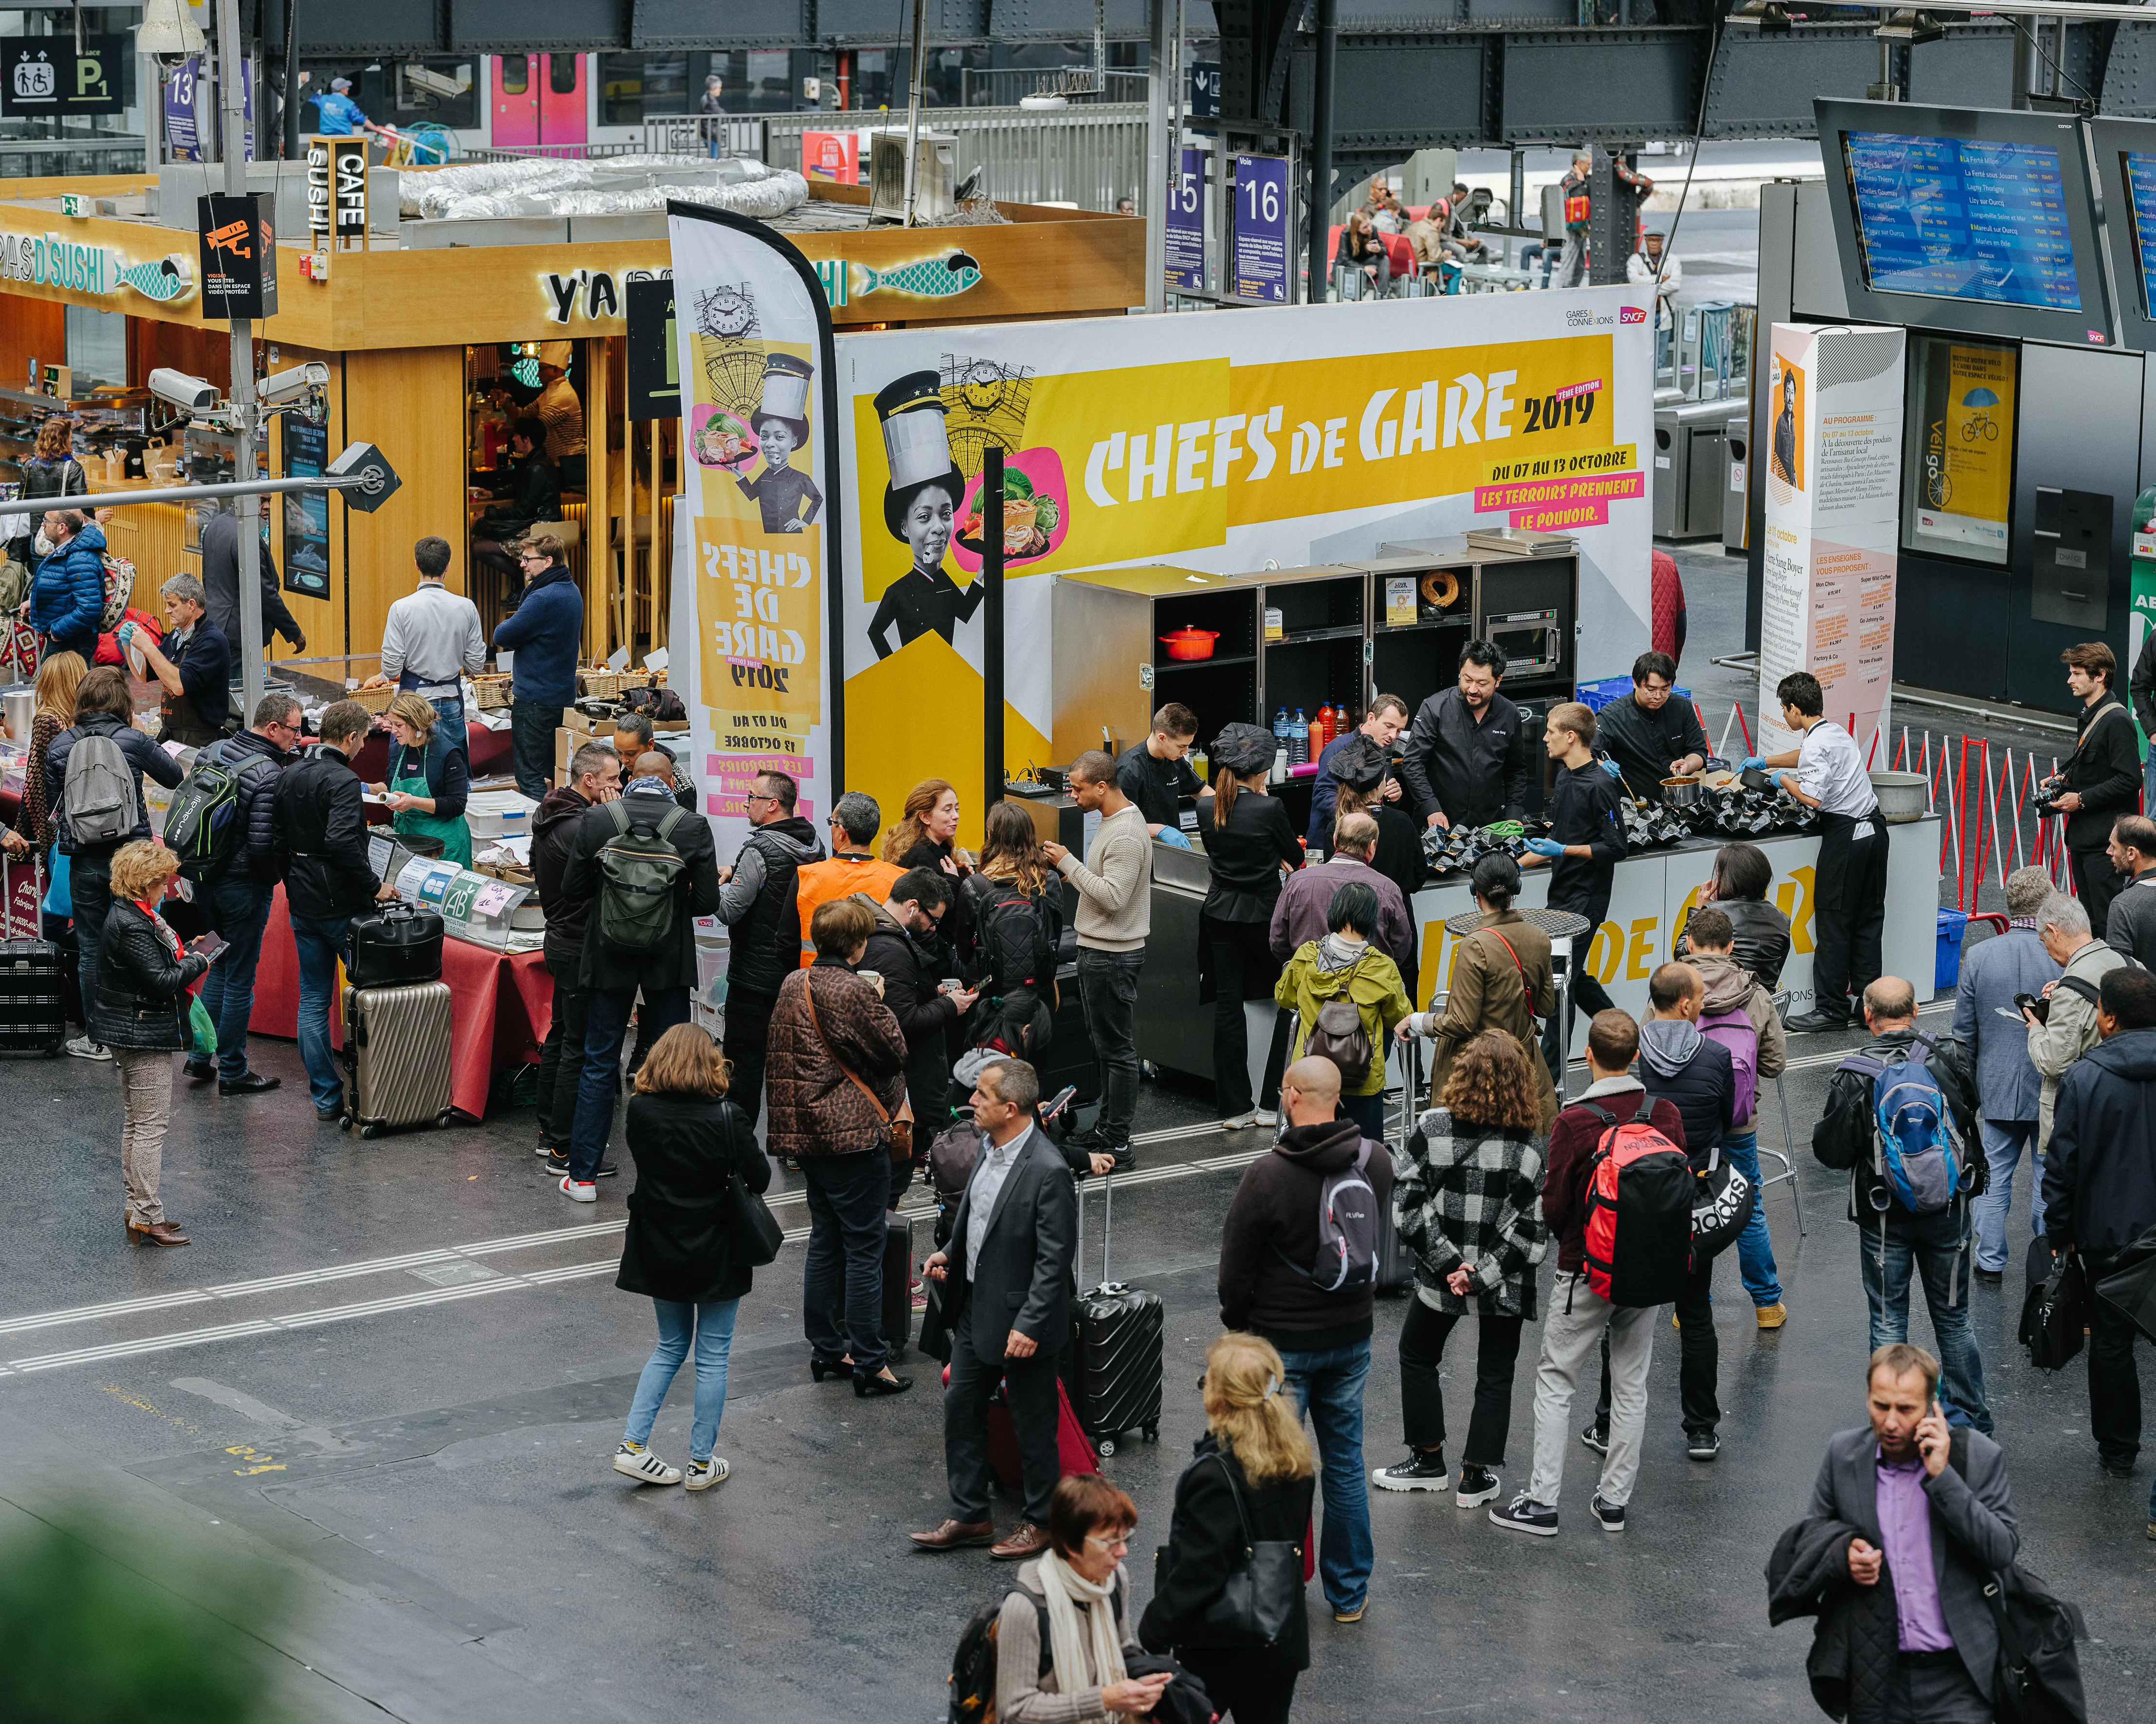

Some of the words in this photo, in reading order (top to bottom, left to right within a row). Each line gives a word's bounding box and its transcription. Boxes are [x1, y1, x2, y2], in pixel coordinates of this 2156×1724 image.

[173, 73, 193, 105] 13
[1888, 149, 1905, 158] Poigny
[1239, 157, 1251, 165] Voie
[308, 148, 328, 230] SUSHI
[338, 154, 365, 225] CAFE
[1171, 173, 1197, 213] 15
[1878, 189, 1897, 198] Gournay
[1967, 183, 1982, 192] Lagny
[1982, 184, 2004, 193] Thorigny
[1246, 180, 1278, 222] 16
[1864, 214, 1895, 222] Coulommiers
[1889, 229, 1904, 237] Ourcq
[2002, 227, 2018, 236] Ourcq
[35, 232, 104, 294] D'SUSHI
[1566, 310, 1588, 319] GARES
[1621, 312, 1645, 322] SNCF
[1568, 316, 1613, 327] CONNEXIONS
[1988, 373, 2005, 381] VÉLIGO
[1558, 388, 1574, 400] 7ÈME
[1575, 380, 1599, 395] ÉDITION
[1522, 391, 1594, 434] 2019
[1834, 415, 1874, 424] PROGRAMME
[1085, 405, 1284, 508] CHEFS
[1290, 417, 1347, 475] DE
[1359, 370, 1517, 462] GARE
[1822, 438, 1827, 447] À
[1873, 436, 1892, 446] produits
[1926, 420, 1943, 479] Véligo
[1492, 465, 1510, 481] DU
[1514, 463, 1528, 478] 07
[1532, 460, 1550, 476] AU
[1554, 458, 1566, 473] 13
[1569, 451, 1627, 472] OCTOBRE
[1482, 490, 1502, 507] LES
[1505, 484, 1567, 504] TERROIRS
[1570, 478, 1637, 498] PRENNENT
[1520, 515, 1534, 530] LE
[1537, 506, 1598, 528] POUVOIR.
[1767, 522, 1771, 535] Le
[1772, 525, 1776, 536] 11
[1777, 529, 1797, 544] octobre
[1766, 549, 1775, 565] Pierre
[1776, 554, 1786, 573] Sang
[1788, 558, 1803, 576] Boyer
[1829, 553, 1861, 563] ENSEIGNES
[2059, 554, 2082, 563] CHANGE
[1816, 567, 1832, 575] VOUS
[1833, 563, 1868, 573] PROPOSENT
[491, 885, 505, 893] Café
[14, 896, 34, 910] Fabrique
[444, 890, 468, 917] AB
[431, 906, 439, 914] VISA
[1586, 916, 1658, 984] DE
[1624, 1139, 1654, 1151] NORTH
